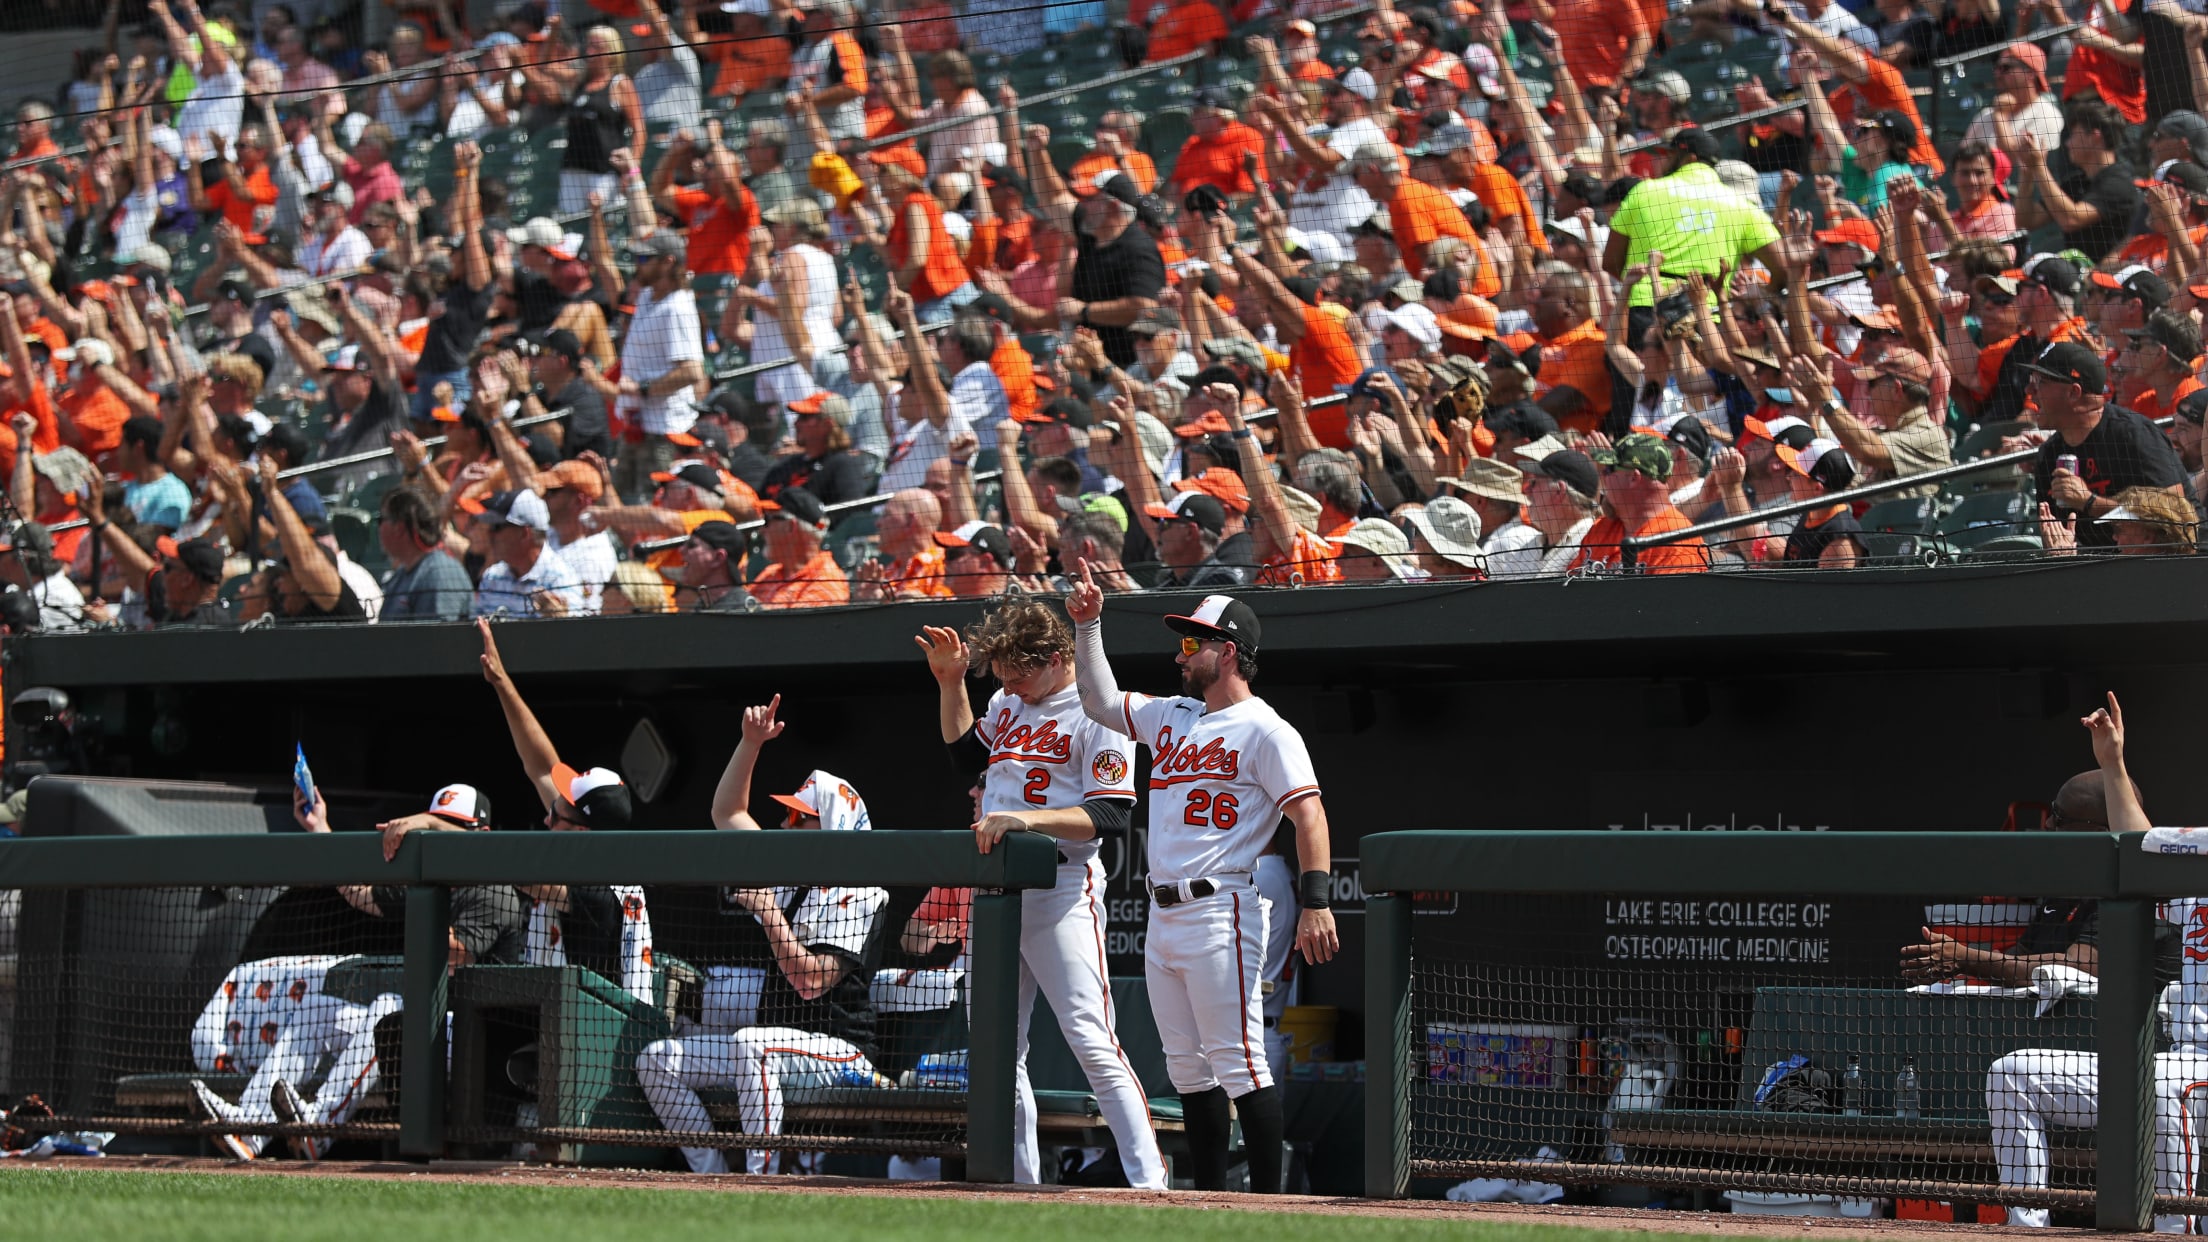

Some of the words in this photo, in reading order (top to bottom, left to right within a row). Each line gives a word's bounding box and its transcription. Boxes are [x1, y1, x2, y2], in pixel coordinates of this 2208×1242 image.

[991, 708, 1072, 758] Oioles
[1152, 725, 1240, 777] Oioles
[1024, 767, 1051, 805] 2
[1184, 788, 1239, 830] 26
[1606, 900, 1653, 925] LAKE
[1659, 901, 1701, 926] ERIE
[1707, 902, 1797, 927] COLLEGE
[1802, 903, 1832, 928] OF
[1606, 935, 1731, 961] OSTEOPATHIC
[1736, 938, 1830, 963] MEDICINE
